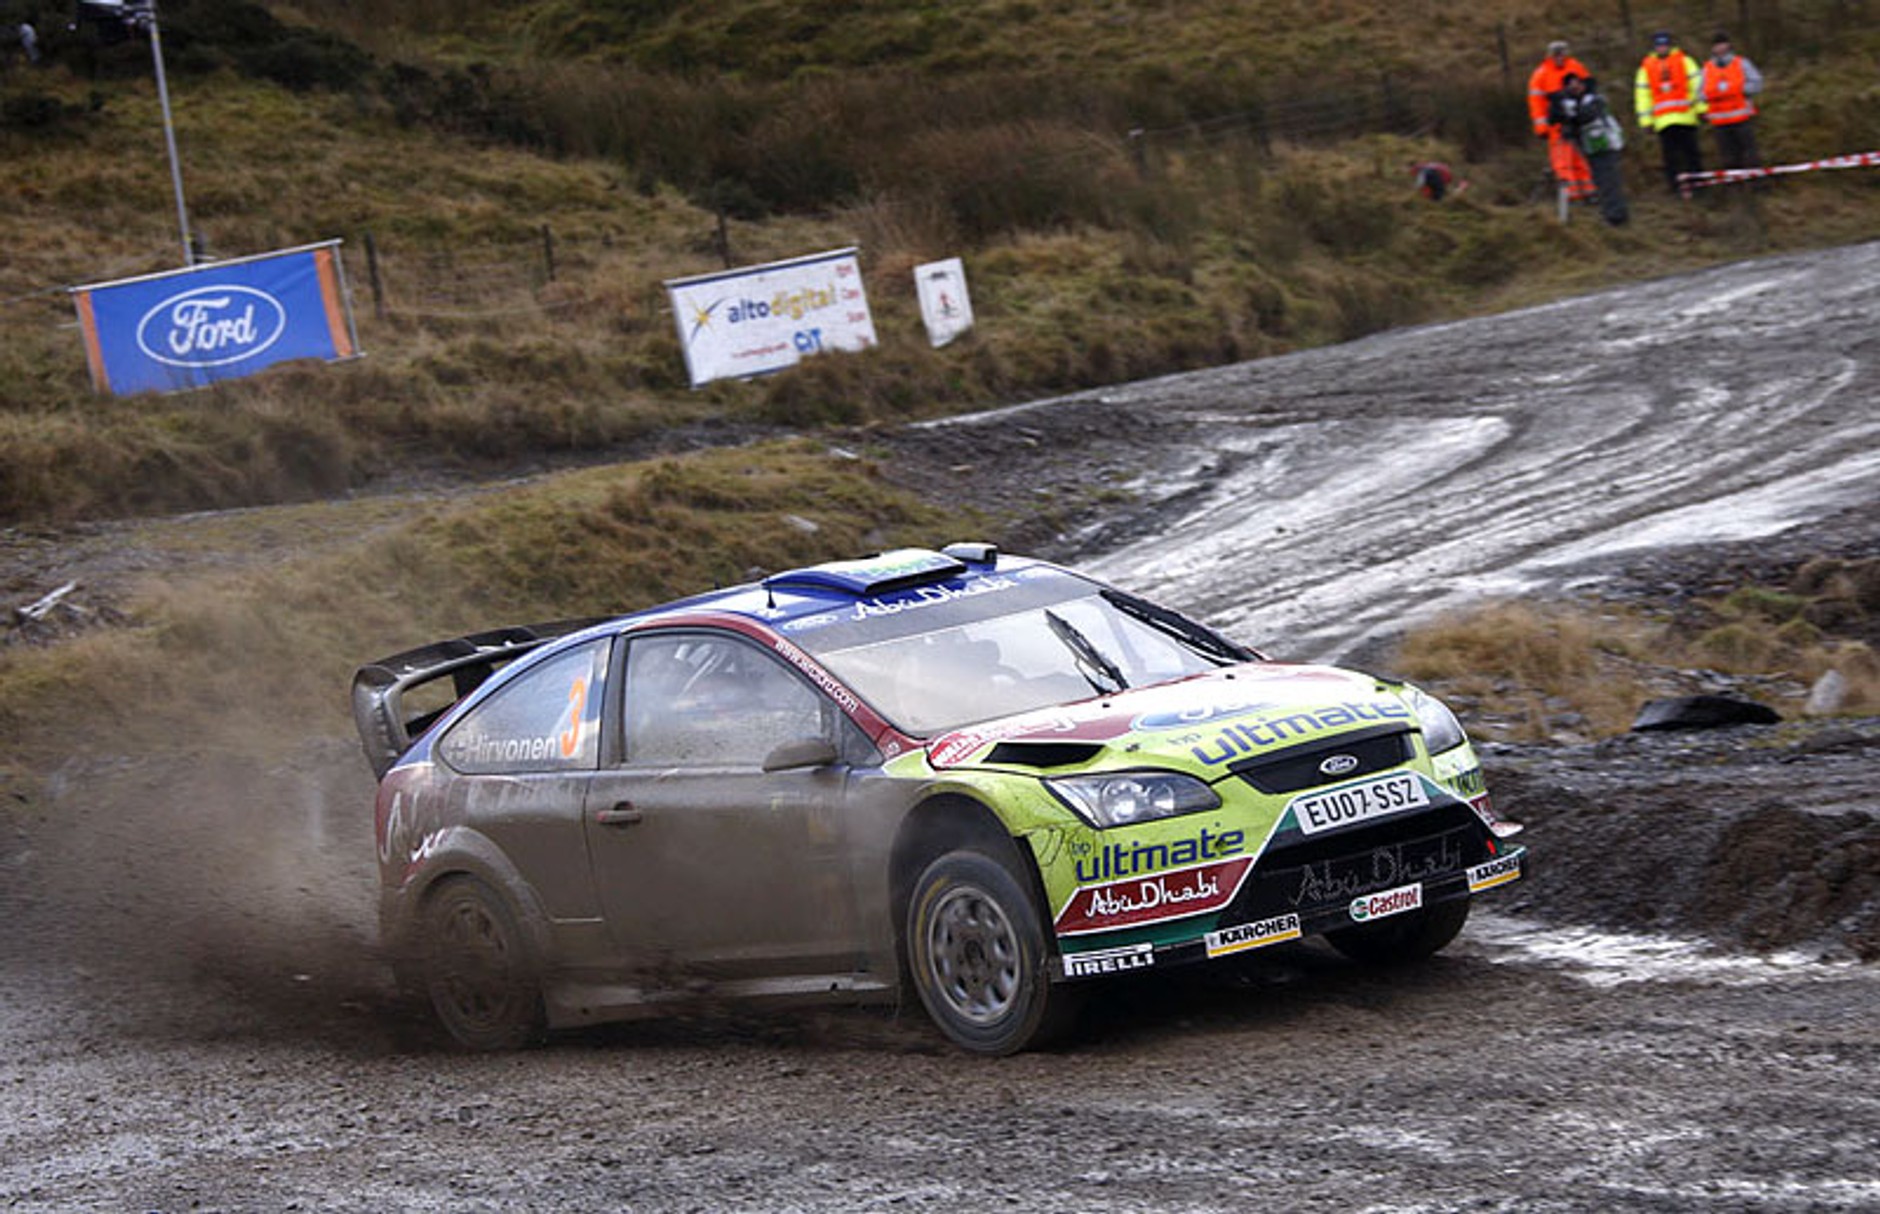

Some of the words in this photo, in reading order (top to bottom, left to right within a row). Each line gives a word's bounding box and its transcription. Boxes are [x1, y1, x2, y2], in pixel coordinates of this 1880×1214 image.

[168, 295, 258, 355] Ford
[727, 281, 838, 324] altodigital
[850, 597, 912, 622] Abu
[561, 675, 586, 758] 3
[1193, 701, 1412, 767] ultimate
[468, 734, 556, 763] Hirvonen
[1304, 789, 1367, 827] EU07
[1372, 778, 1419, 810] SSZ
[1075, 828, 1245, 883] ultimate
[1289, 858, 1359, 906] Abu
[1372, 836, 1461, 887] Dhabi
[1085, 889, 1138, 918] Abu
[1139, 870, 1220, 908] Dhabi
[1368, 887, 1419, 916] Castrol
